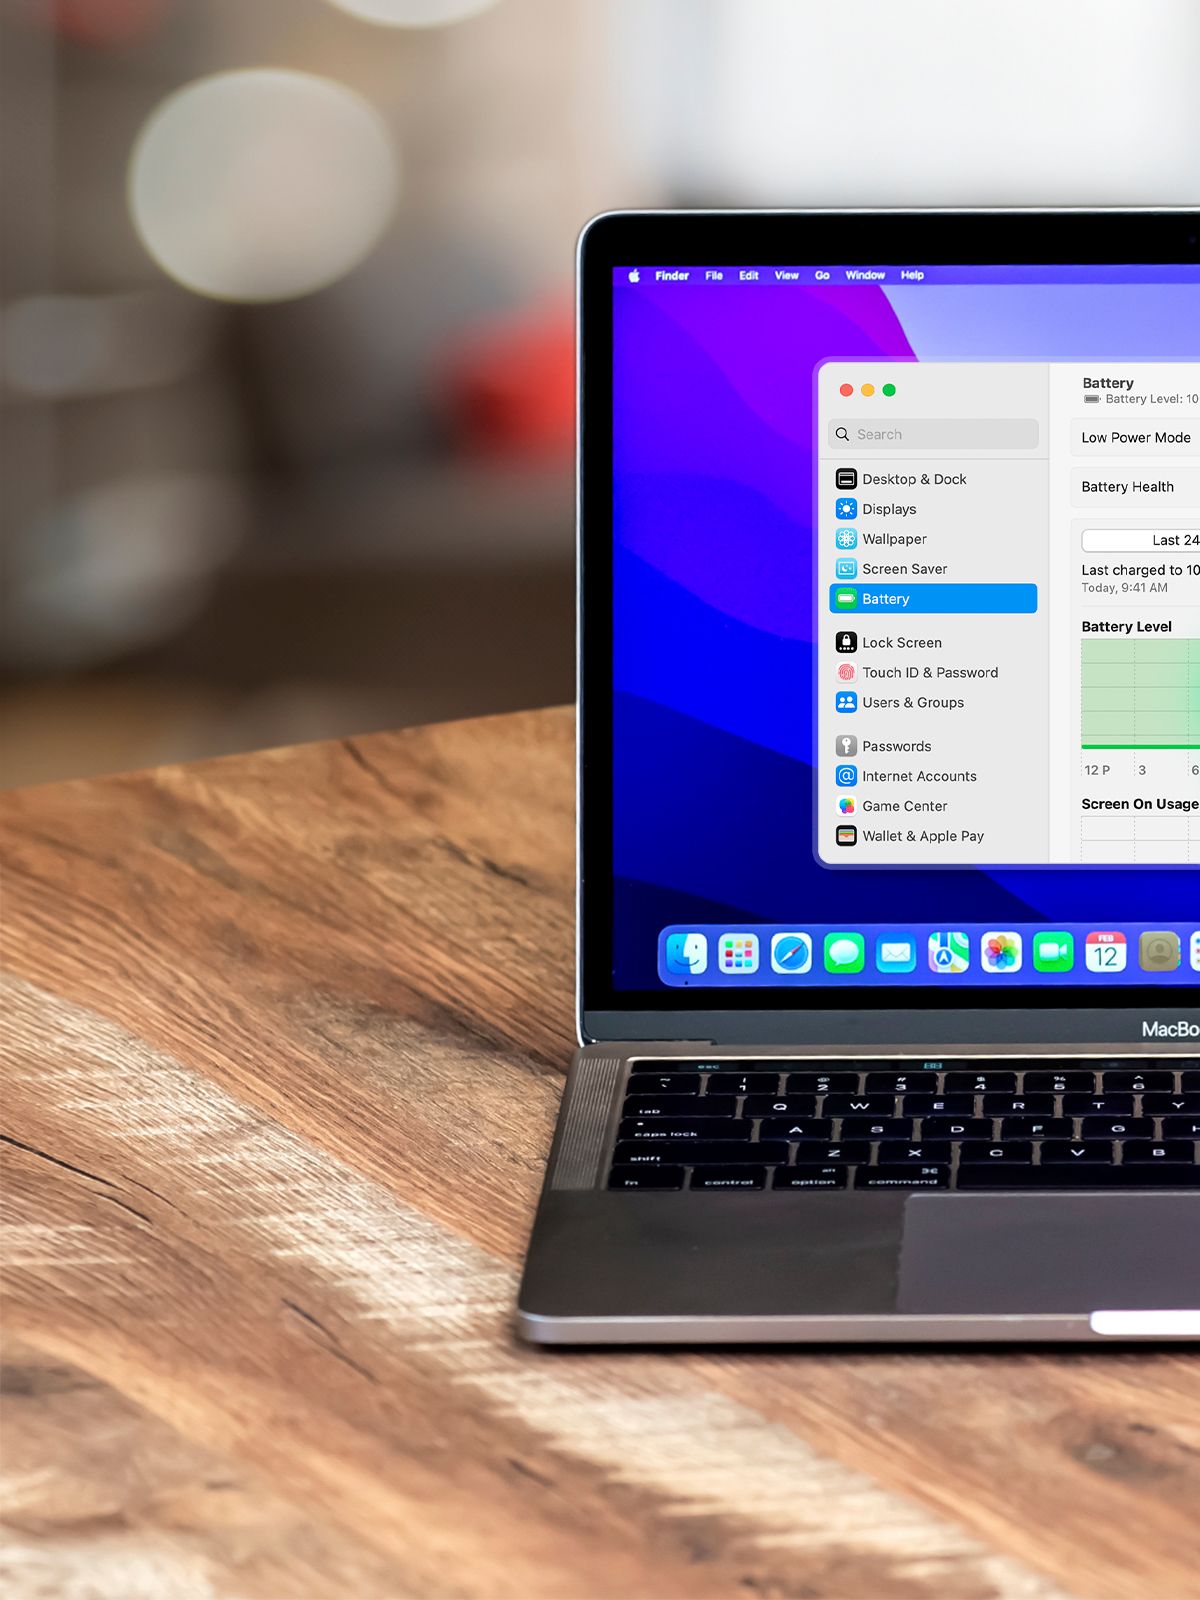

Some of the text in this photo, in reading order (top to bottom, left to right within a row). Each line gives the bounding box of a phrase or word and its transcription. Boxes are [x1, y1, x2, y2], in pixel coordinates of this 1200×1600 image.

[655, 269, 925, 282] Finder File Edit View Go Window Help
[1083, 377, 1135, 392] Battery
[1106, 393, 1147, 406] Battery
[1150, 393, 1183, 404] Level:
[857, 428, 902, 441] Search
[1082, 431, 1191, 444] Low Power Mode
[863, 473, 967, 487] Desktop & Dock
[1082, 480, 1174, 495] Battery Health
[863, 503, 917, 518] Displays
[862, 532, 928, 547] Wallpaper
[1153, 534, 1180, 546] Last
[1183, 534, 1200, 546] 24
[862, 563, 948, 575] Screen Saver
[1082, 564, 1109, 576] Last
[1112, 563, 1166, 579] charged
[1169, 564, 1183, 576] to
[1081, 582, 1168, 595] Today, 9:41 AM
[862, 592, 910, 607] Battery
[1082, 620, 1172, 635] Battery Level
[863, 636, 942, 649] Lock Screen
[862, 666, 999, 679] Touch ID & Password
[863, 696, 965, 711] Users & Groups
[863, 740, 932, 752] Passwords
[863, 770, 977, 782] Internet Accounts
[1084, 764, 1111, 776] 12 P
[1138, 764, 1147, 776] 3
[1191, 764, 1200, 776] 6
[862, 800, 948, 812] Game Center
[1081, 798, 1200, 813] Screen On Usage
[862, 829, 985, 845] Wallet & Apple Pay
[1094, 946, 1117, 967] 12
[772, 1102, 788, 1111] Q
[849, 1102, 870, 1110] W
[932, 1102, 945, 1110] E
[1012, 1102, 1026, 1110] R
[1092, 1101, 1106, 1110] T
[1171, 1101, 1185, 1109] Y
[788, 1126, 804, 1134] A
[870, 1125, 884, 1134] S
[950, 1125, 965, 1134] D
[1032, 1125, 1044, 1133] F
[1110, 1124, 1126, 1133] G
[827, 1149, 841, 1158] Z
[908, 1148, 923, 1157] X
[989, 1148, 1004, 1157] C
[1070, 1148, 1086, 1157] V
[1152, 1148, 1166, 1157] B
